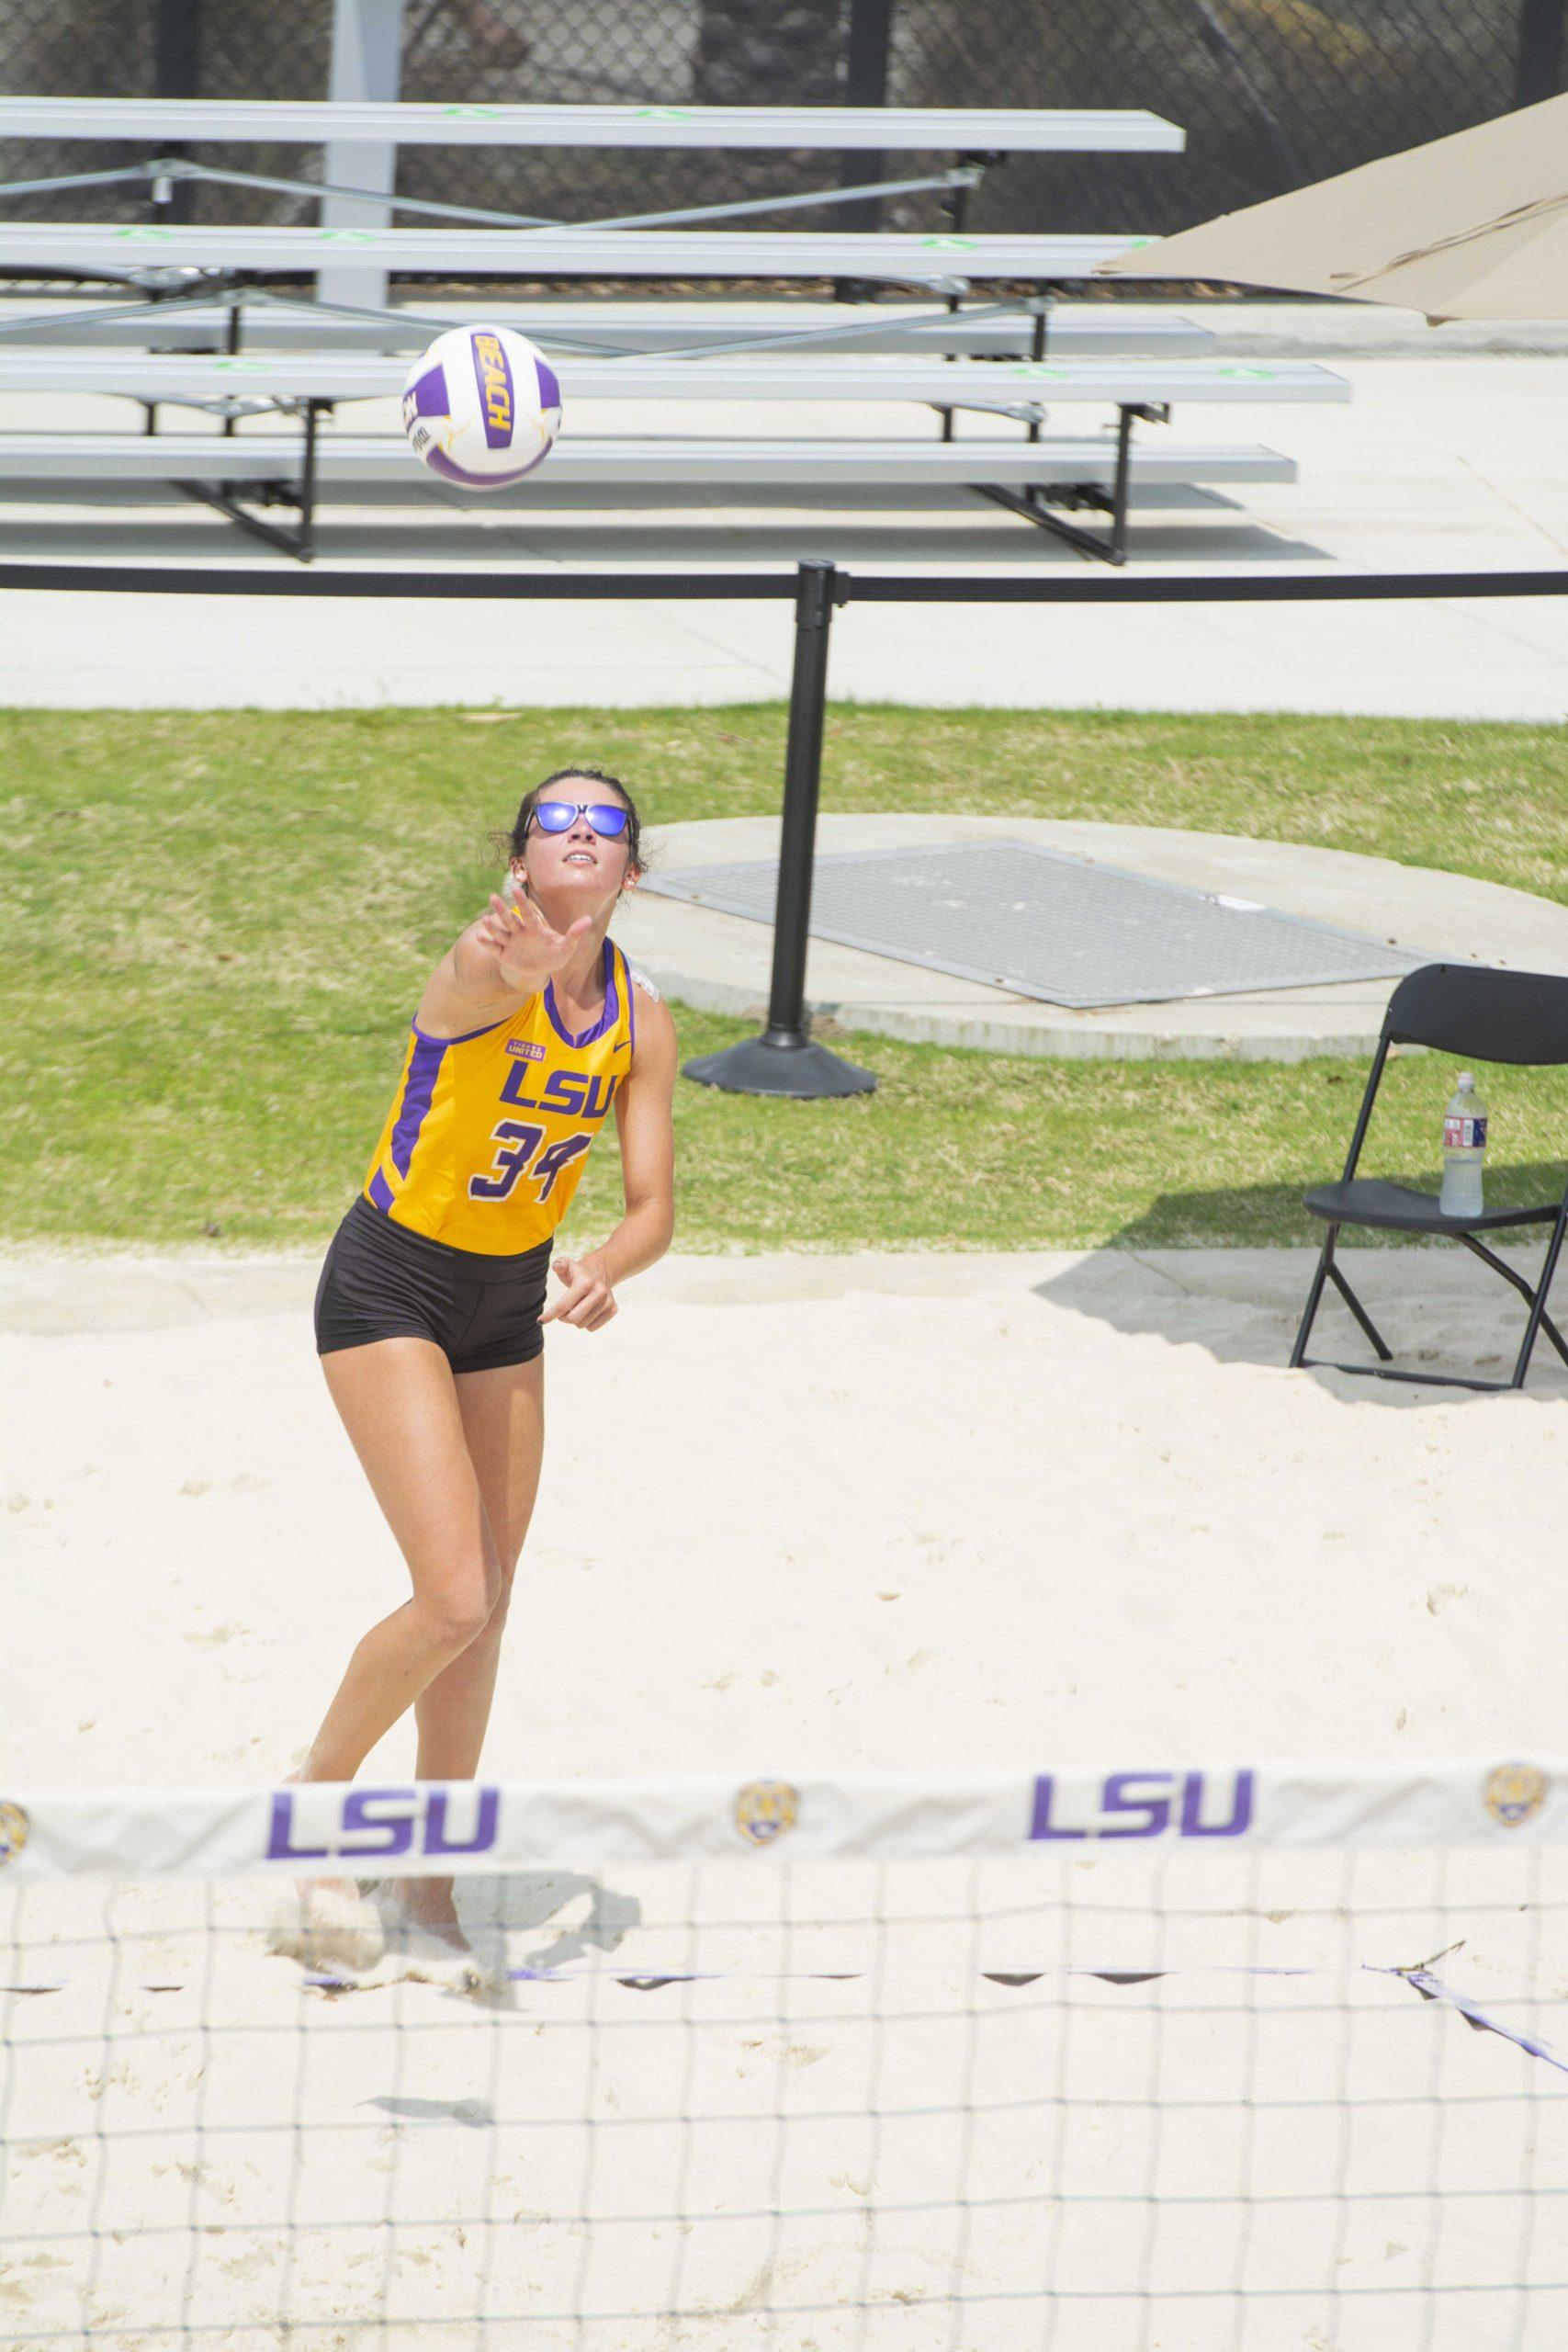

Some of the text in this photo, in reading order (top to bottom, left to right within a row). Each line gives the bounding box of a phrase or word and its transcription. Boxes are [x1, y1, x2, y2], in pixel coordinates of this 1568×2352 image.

[474, 334, 512, 432] BEACH
[508, 1045, 543, 1058] UNITED
[499, 1059, 618, 1118] LSU
[468, 1117, 594, 1204] 34
[265, 1788, 500, 1860] LSU
[1028, 1770, 1254, 1840] LSU
